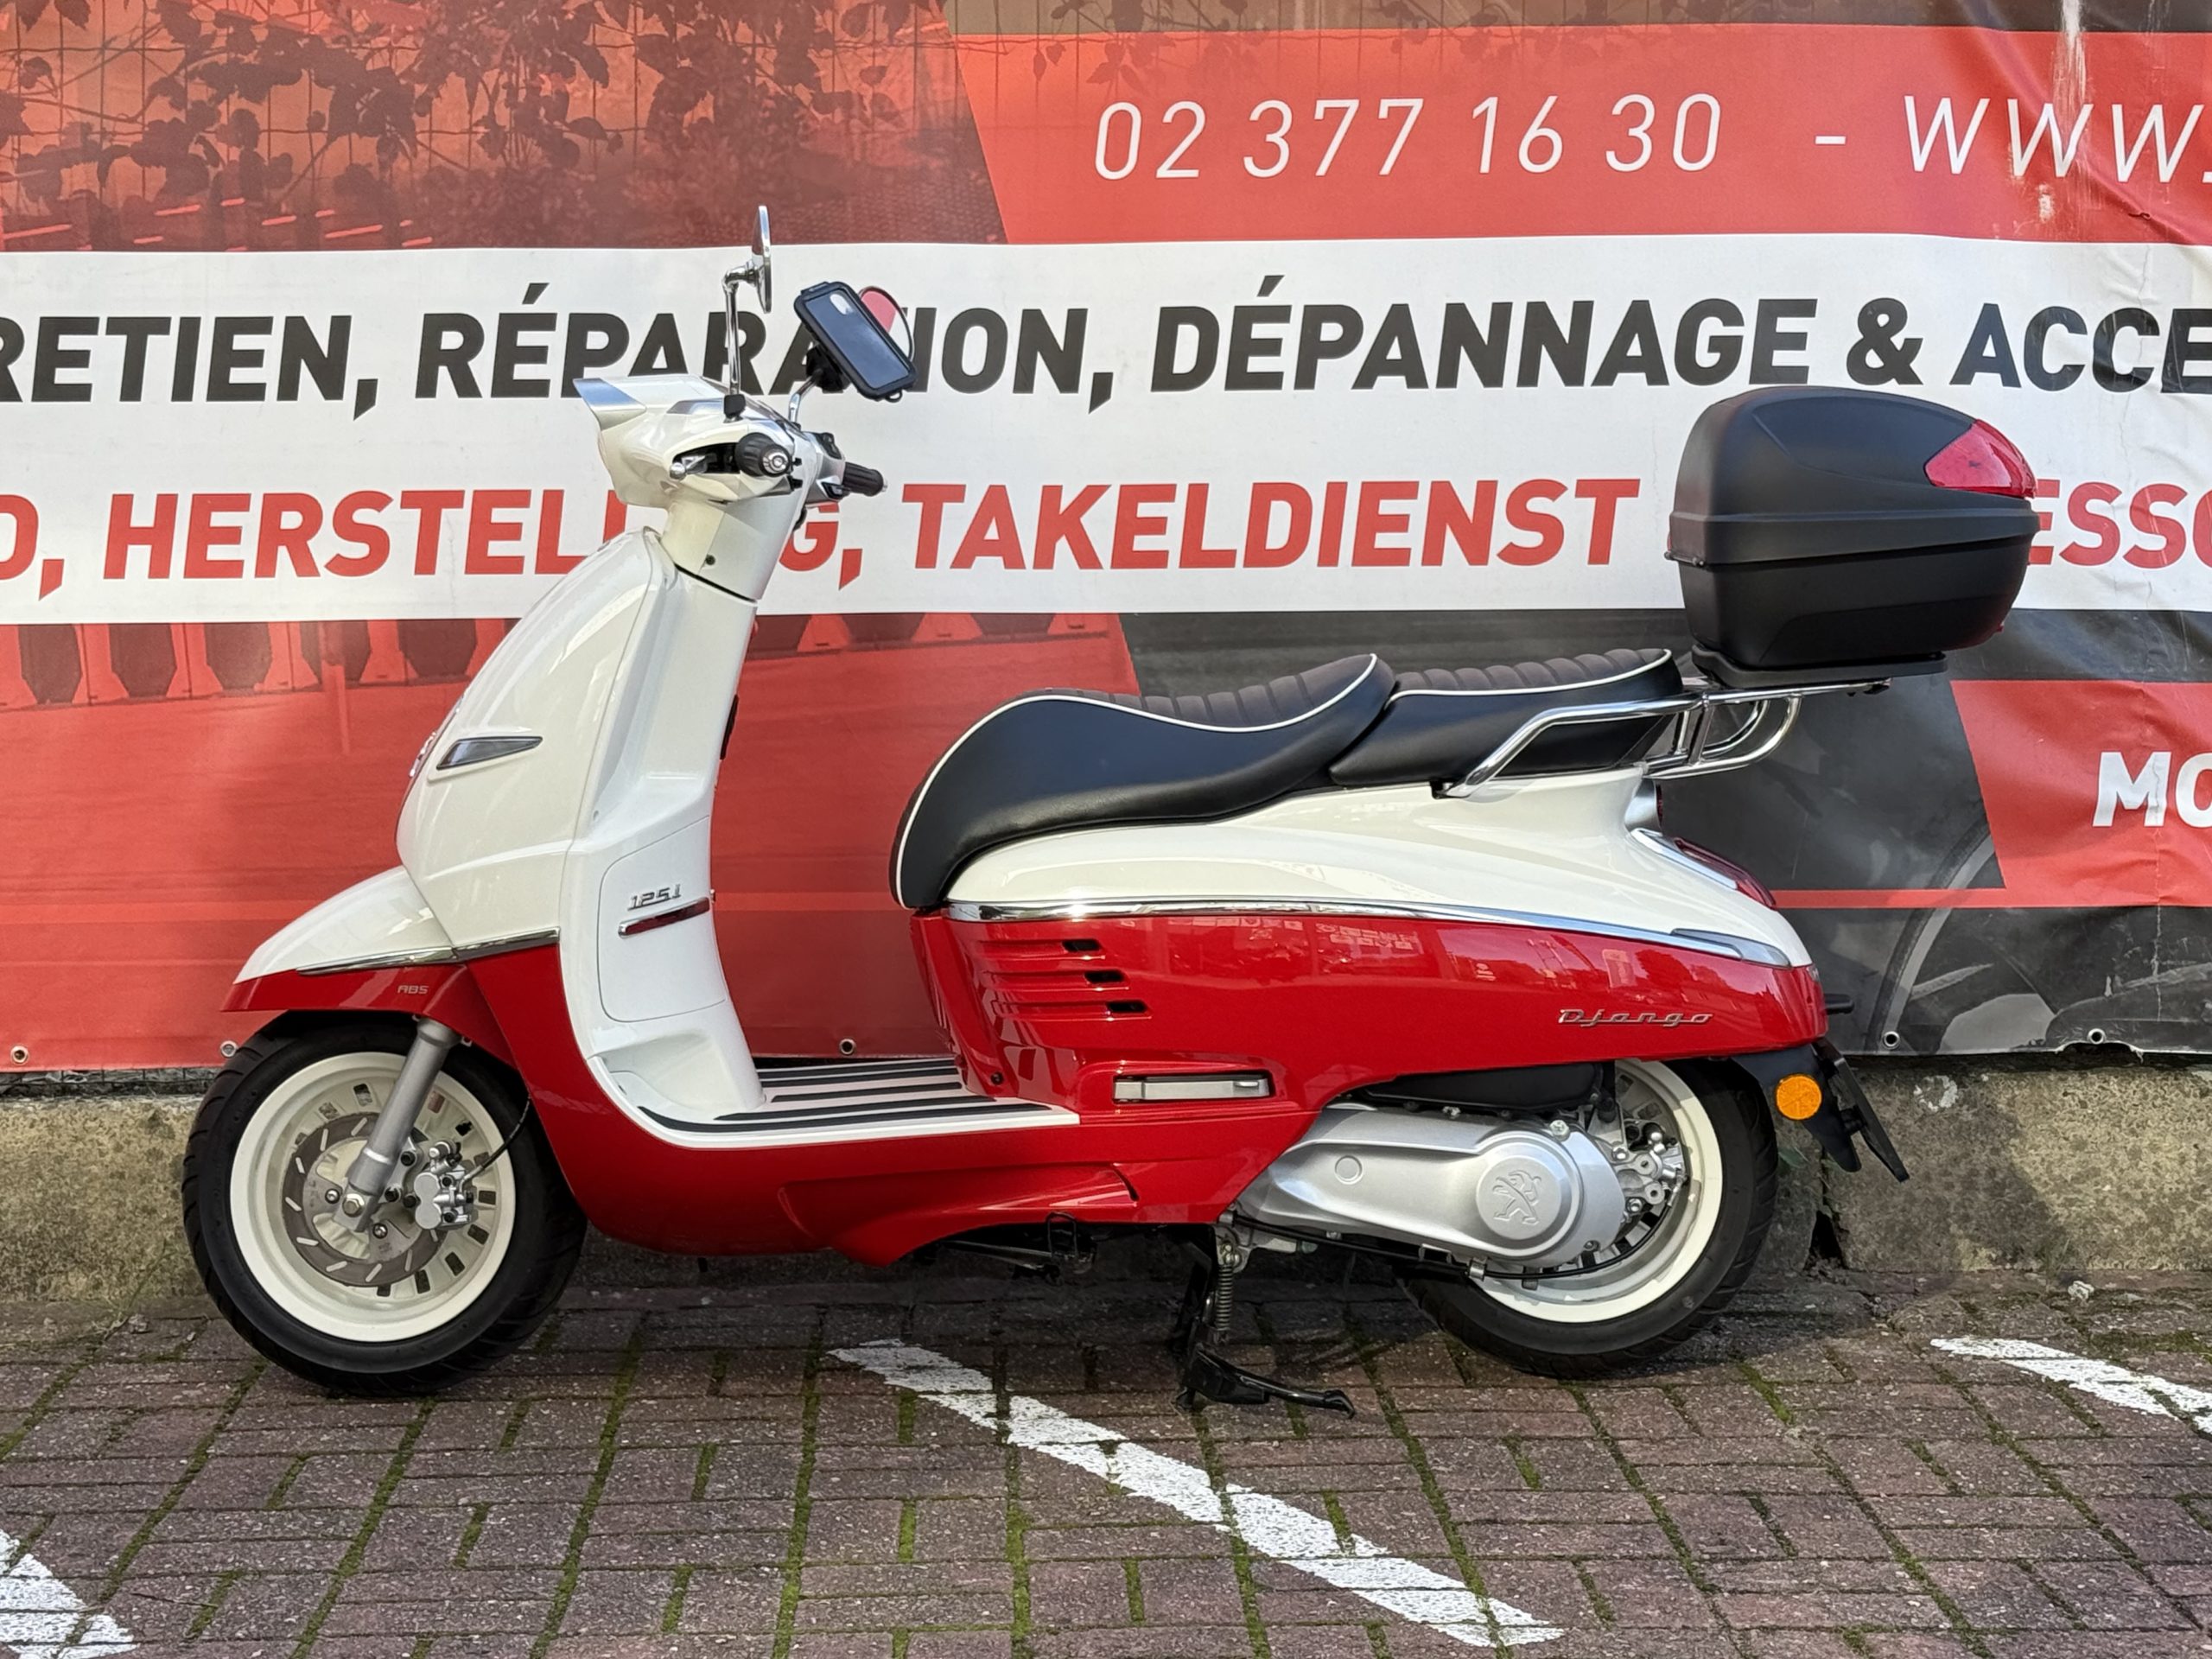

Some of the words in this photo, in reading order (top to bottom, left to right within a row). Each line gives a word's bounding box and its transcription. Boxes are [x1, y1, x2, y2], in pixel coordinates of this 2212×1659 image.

[1095, 101, 1205, 180] 02
[1244, 98, 1423, 177] 377
[1472, 95, 1563, 174] 16
[1605, 93, 1720, 172] 30
[416, 283, 1114, 414] RÉPARION,
[1151, 275, 1818, 394] DÉPANNAGE
[1846, 297, 1923, 386] &
[1949, 302, 2212, 396] ACCE
[104, 489, 862, 591] HERSTELG,
[902, 478, 1639, 570] TAKELDIENST
[2028, 479, 2212, 569] SS
[397, 984, 429, 995] ABS
[1558, 1008, 1713, 1028] Django
